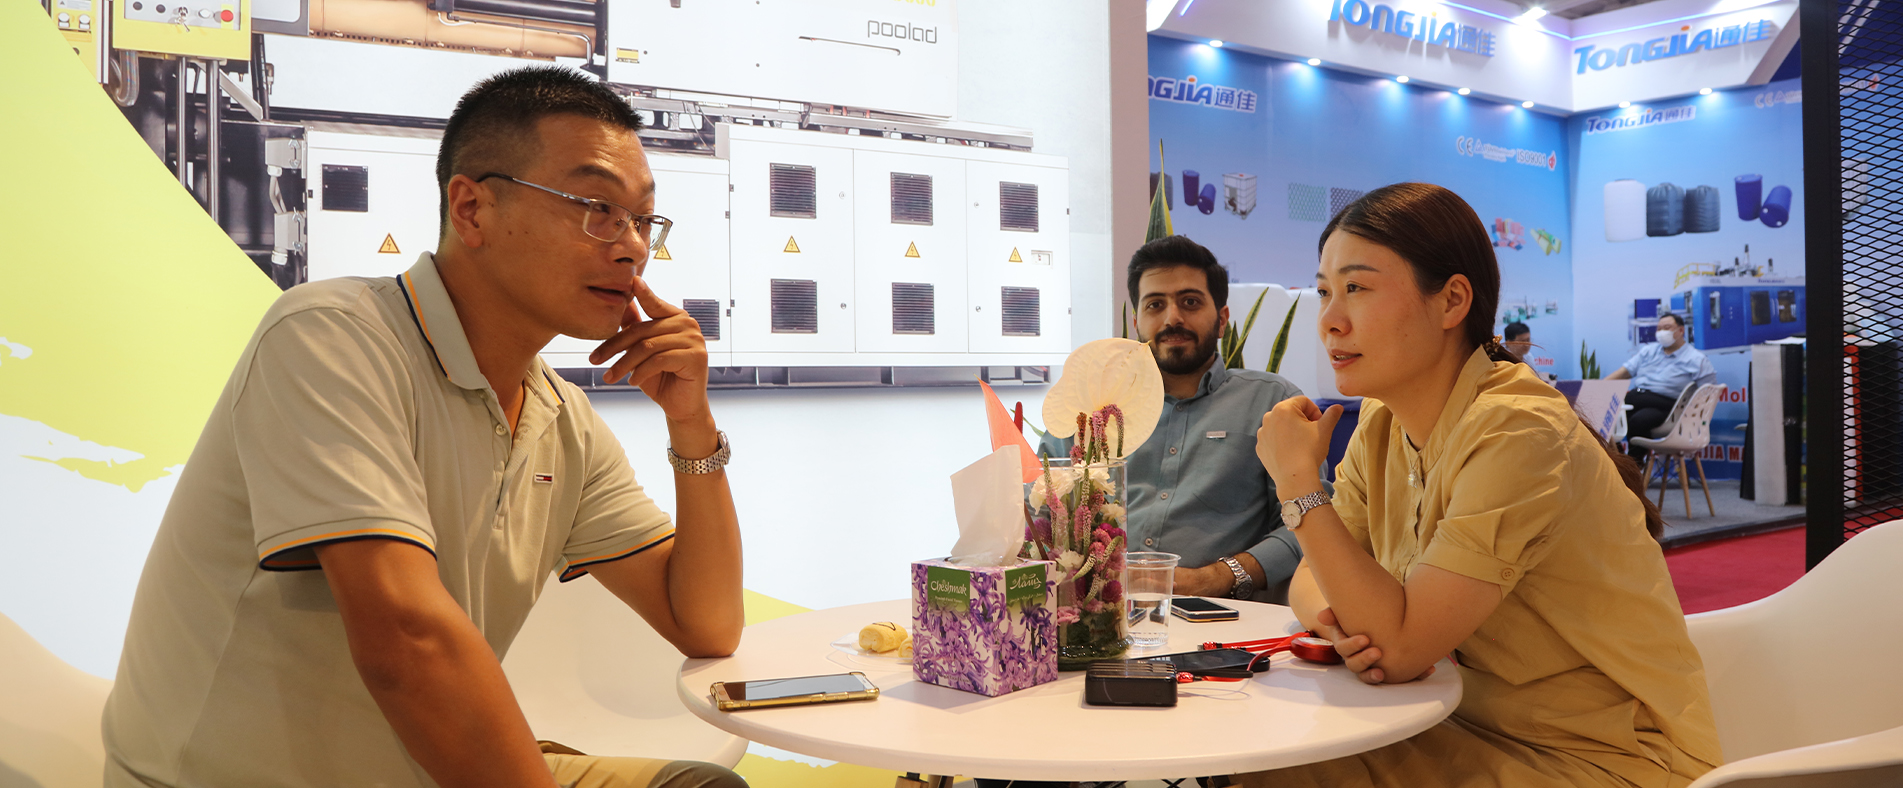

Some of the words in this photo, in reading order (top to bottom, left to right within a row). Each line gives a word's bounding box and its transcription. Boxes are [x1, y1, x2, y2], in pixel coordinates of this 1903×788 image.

[867, 20, 937, 44] poolad
[1214, 87, 1255, 111] 通佳
[930, 580, 967, 596] Cheshmak
